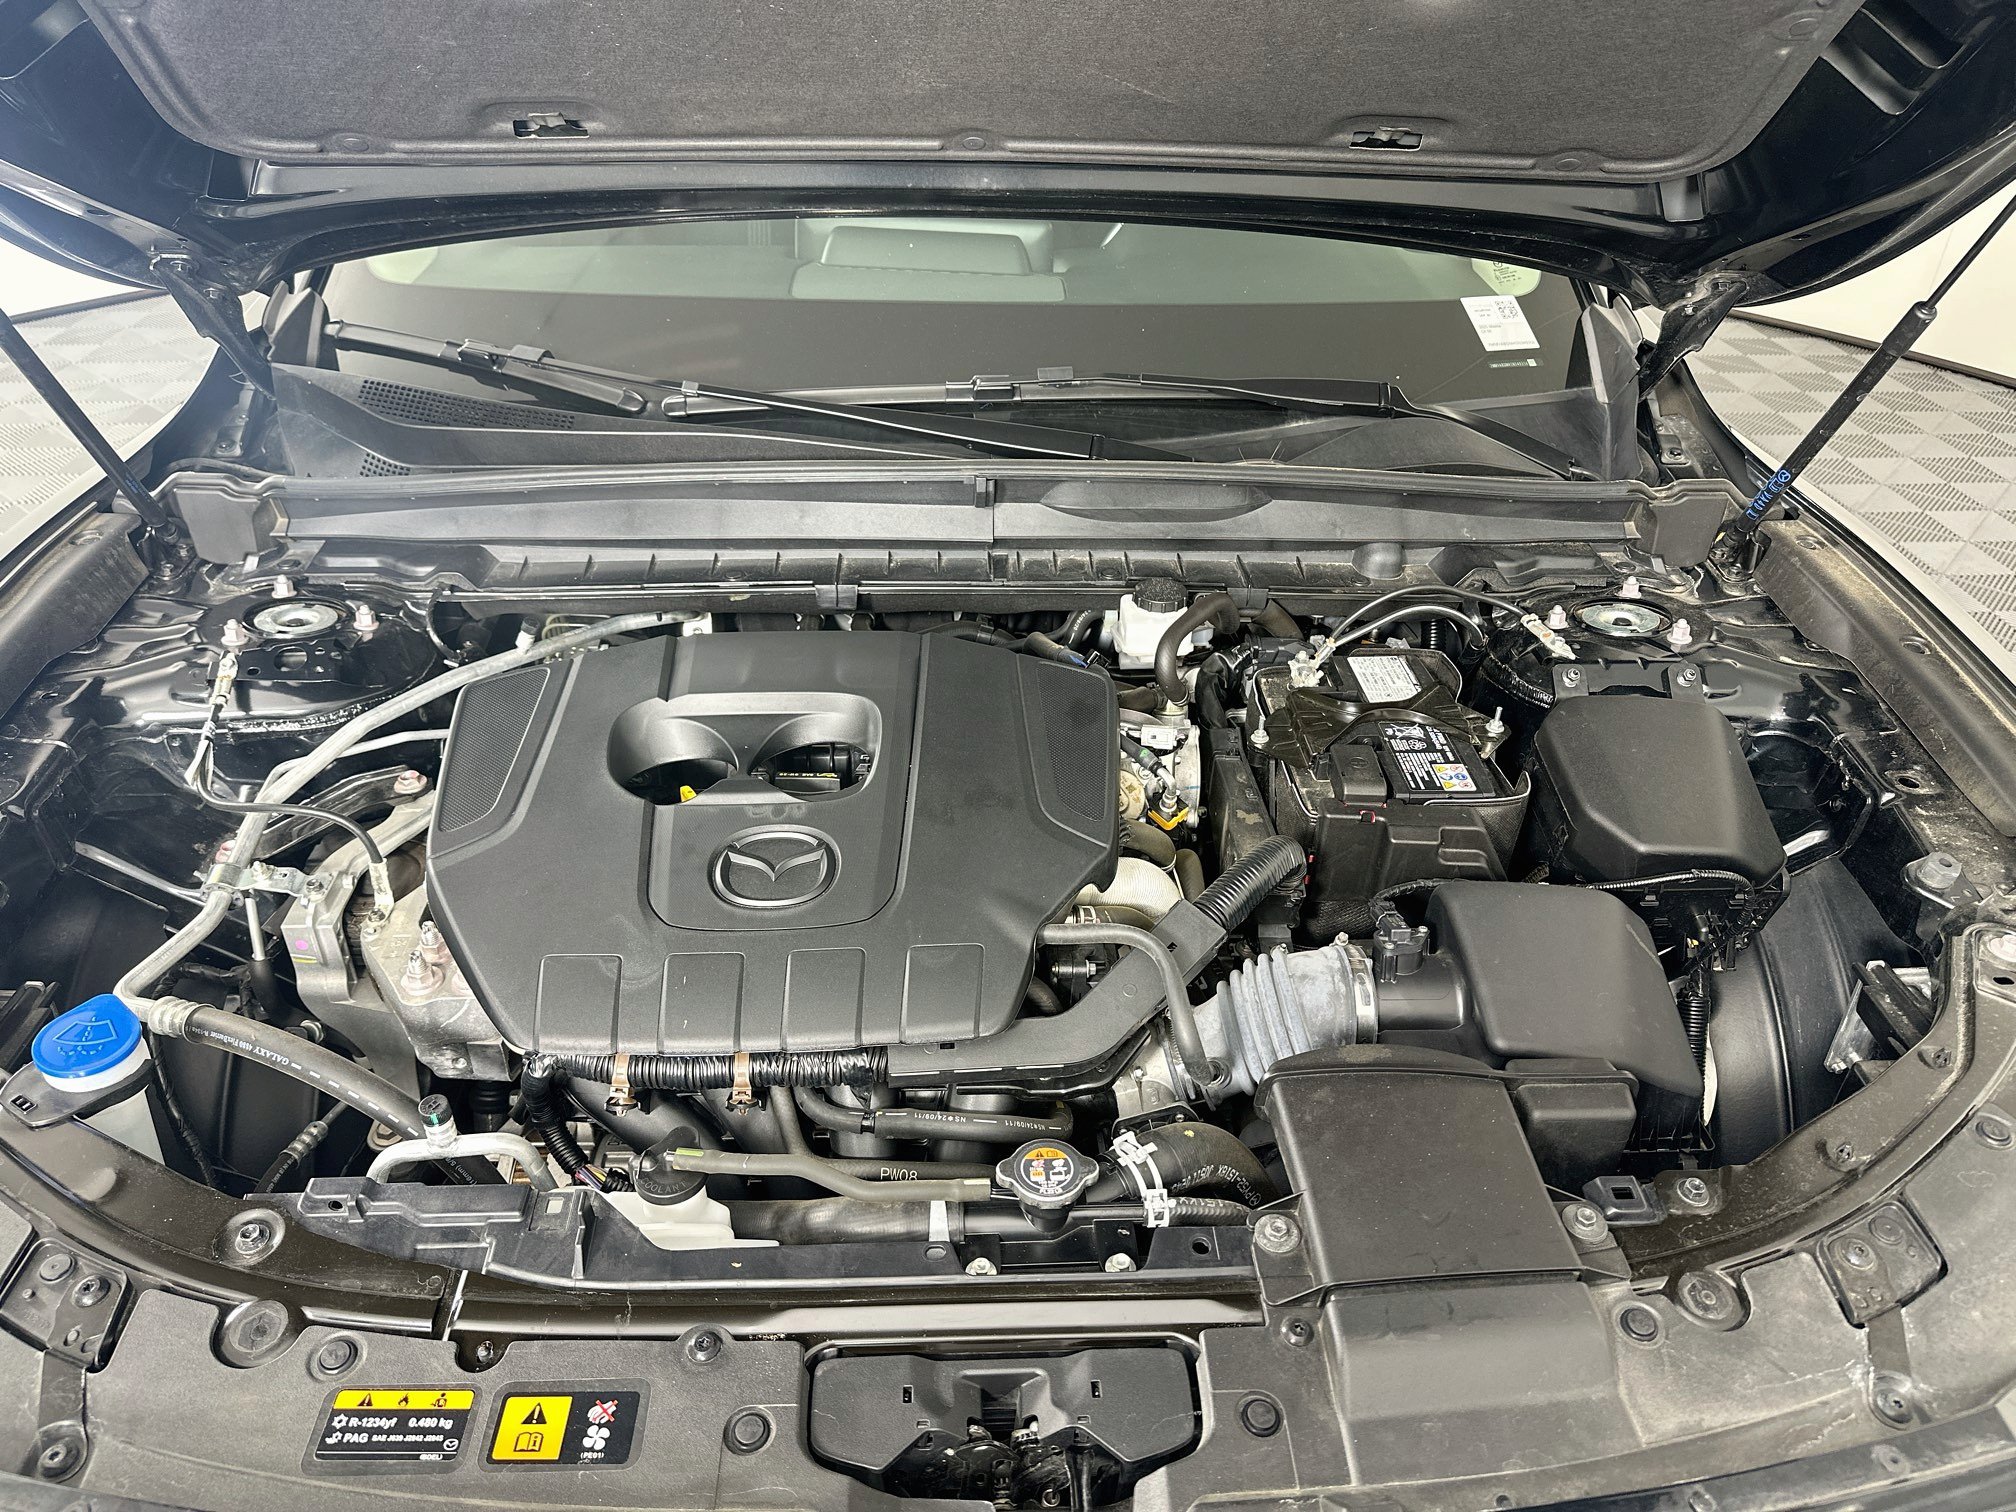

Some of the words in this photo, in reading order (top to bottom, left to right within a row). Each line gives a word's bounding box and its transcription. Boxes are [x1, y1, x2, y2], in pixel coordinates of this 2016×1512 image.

[252, 1046, 289, 1066] GALAXY
[640, 1177, 689, 1194] COOLANT
[348, 1417, 397, 1429] R-1234yf
[408, 1417, 437, 1428] 0.480
[437, 1417, 454, 1430] kg
[342, 1432, 369, 1443] PAG
